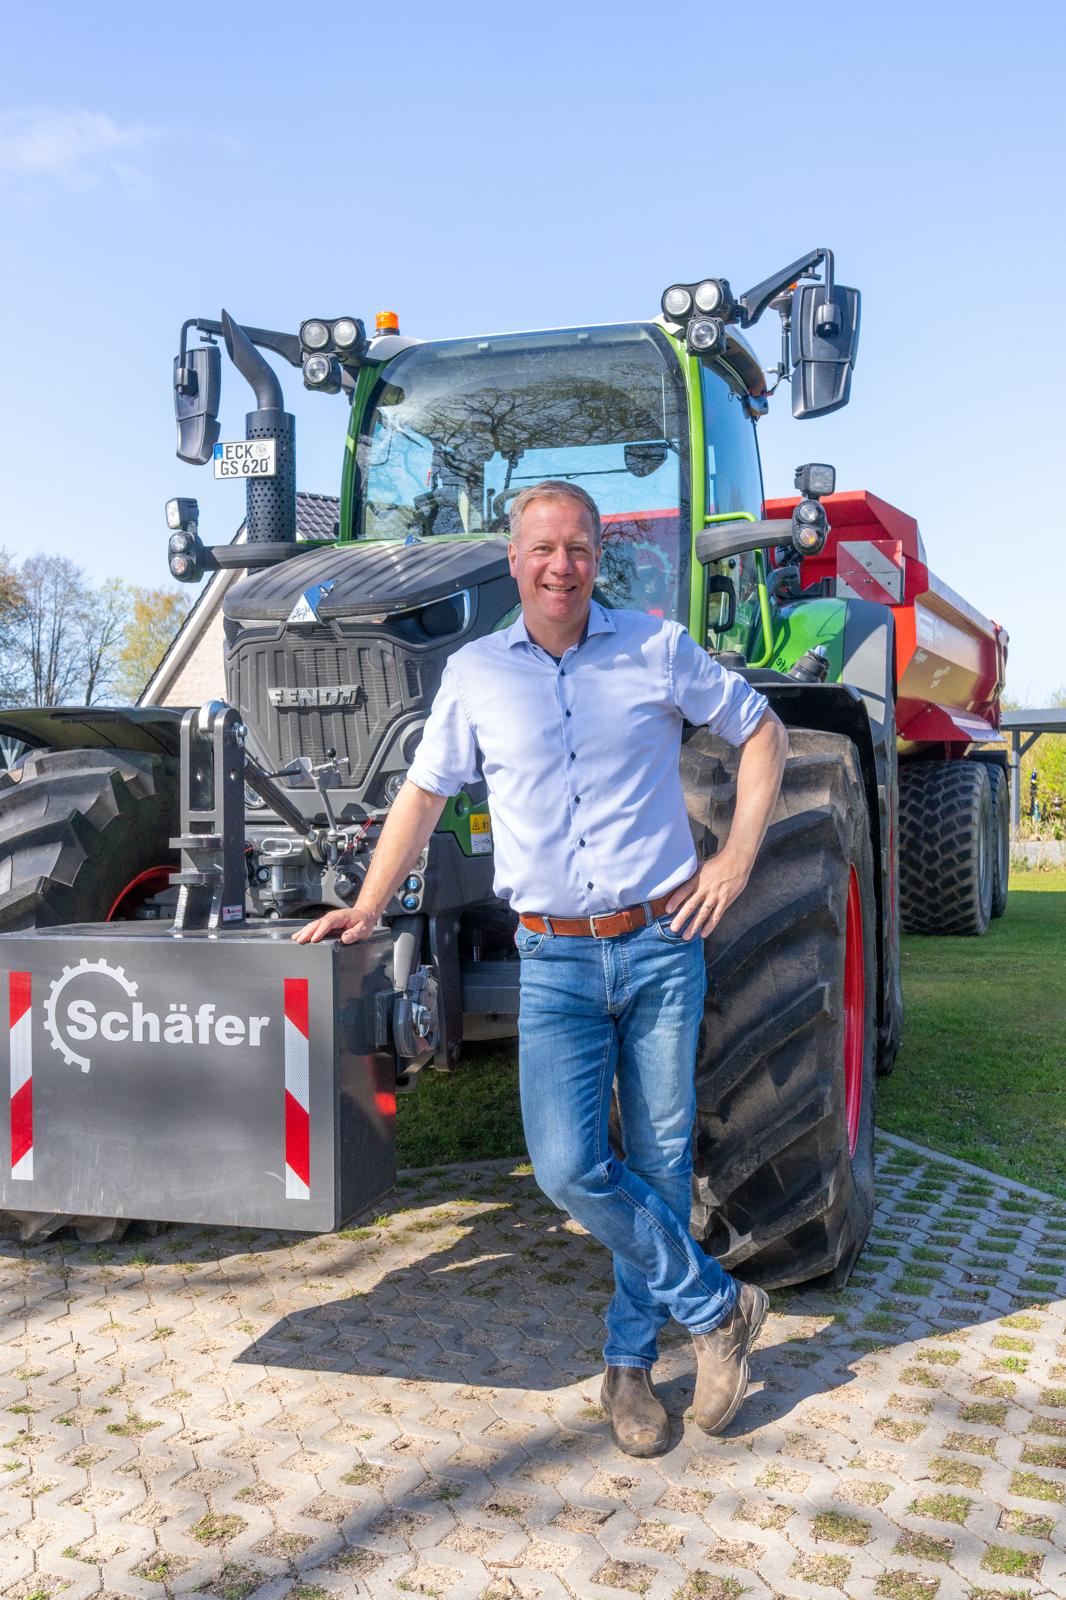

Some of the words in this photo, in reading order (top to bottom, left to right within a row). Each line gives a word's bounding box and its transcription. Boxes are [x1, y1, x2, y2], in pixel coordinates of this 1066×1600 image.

[225, 444, 253, 460] ECK
[221, 460, 239, 476] GS
[242, 459, 269, 474] 620
[267, 685, 360, 707] FENDT
[66, 1000, 271, 1047] Schäfer
